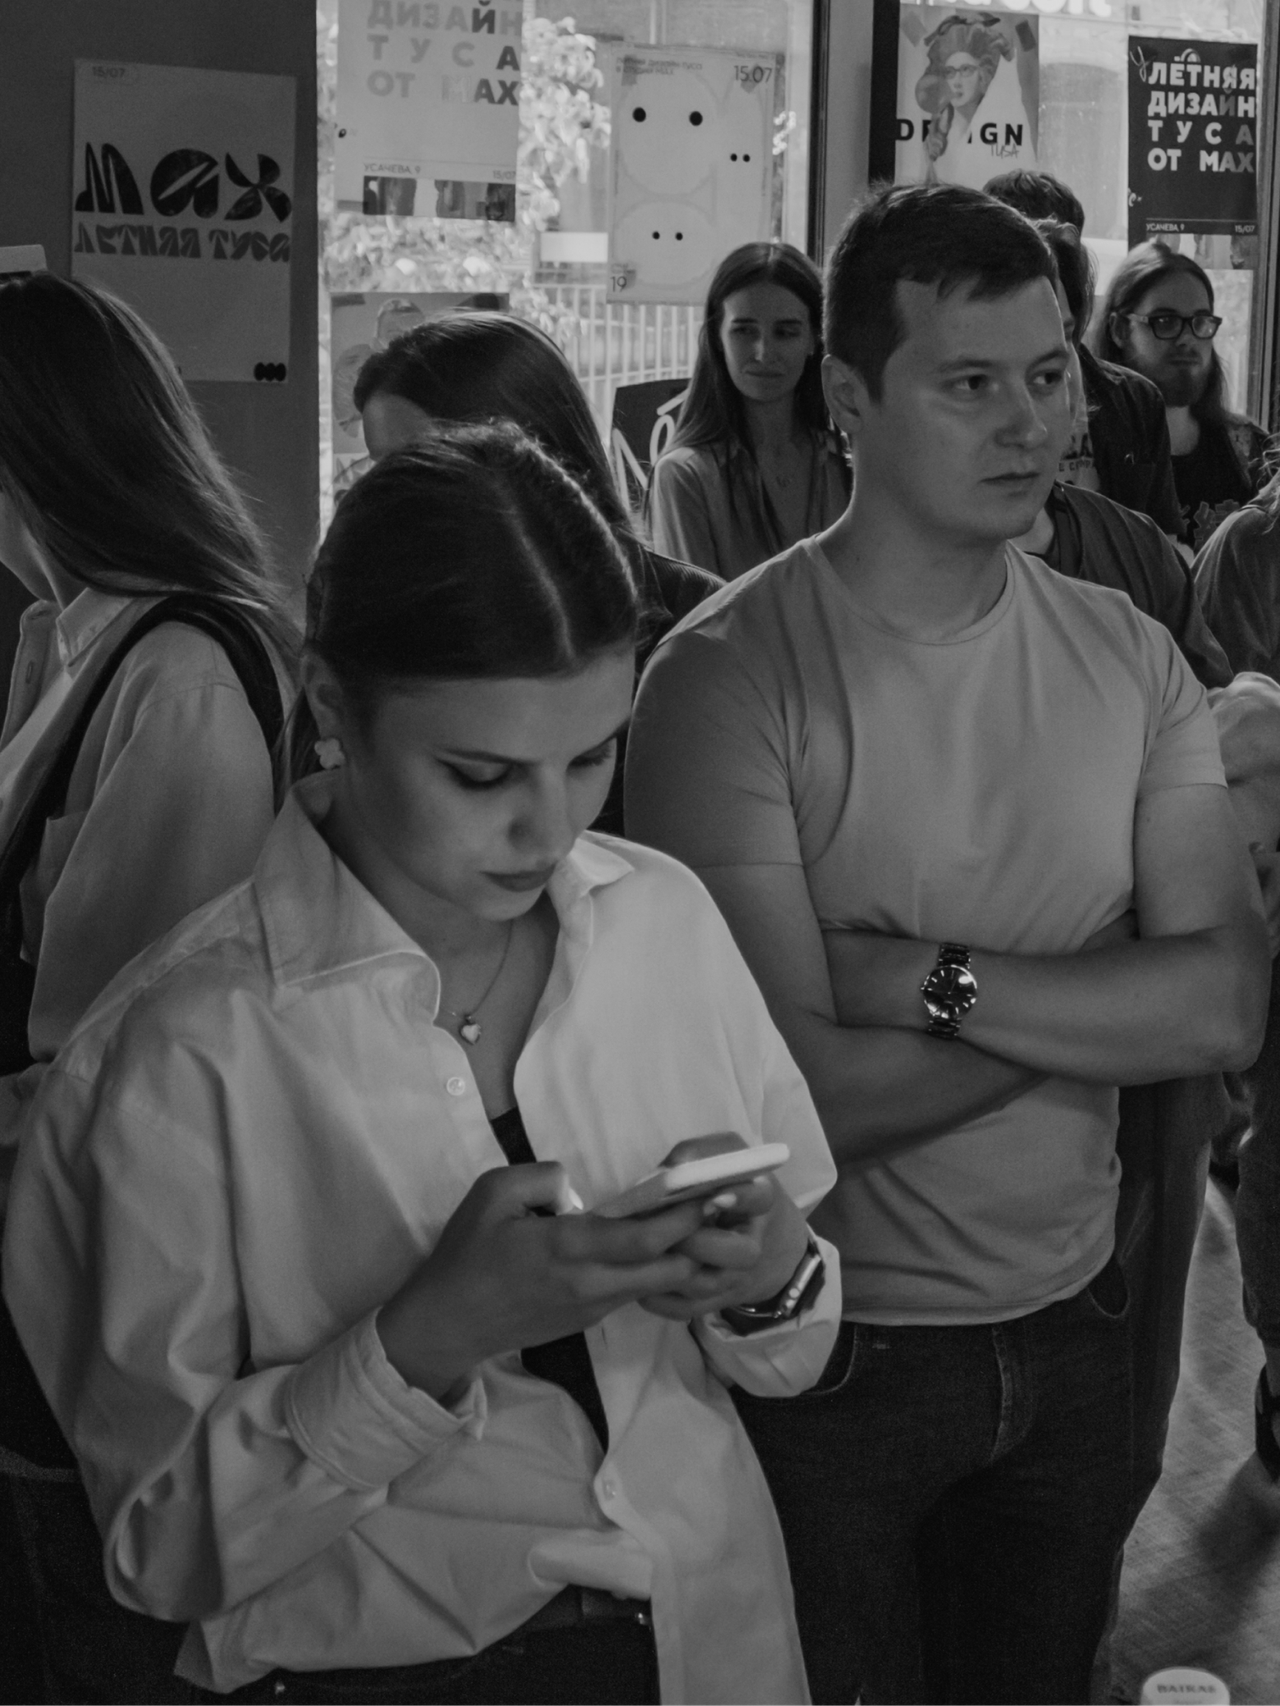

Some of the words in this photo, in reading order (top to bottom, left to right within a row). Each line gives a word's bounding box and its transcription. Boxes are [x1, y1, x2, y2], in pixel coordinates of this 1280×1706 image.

[367, 0, 521, 36] ДИЗАЙН
[367, 70, 416, 98] ОТ
[734, 65, 772, 83] 15.07
[1148, 87, 1256, 118] ДИЗАЙН
[1148, 119, 1254, 146] ТУСА
[1147, 147, 1182, 172] ОТ
